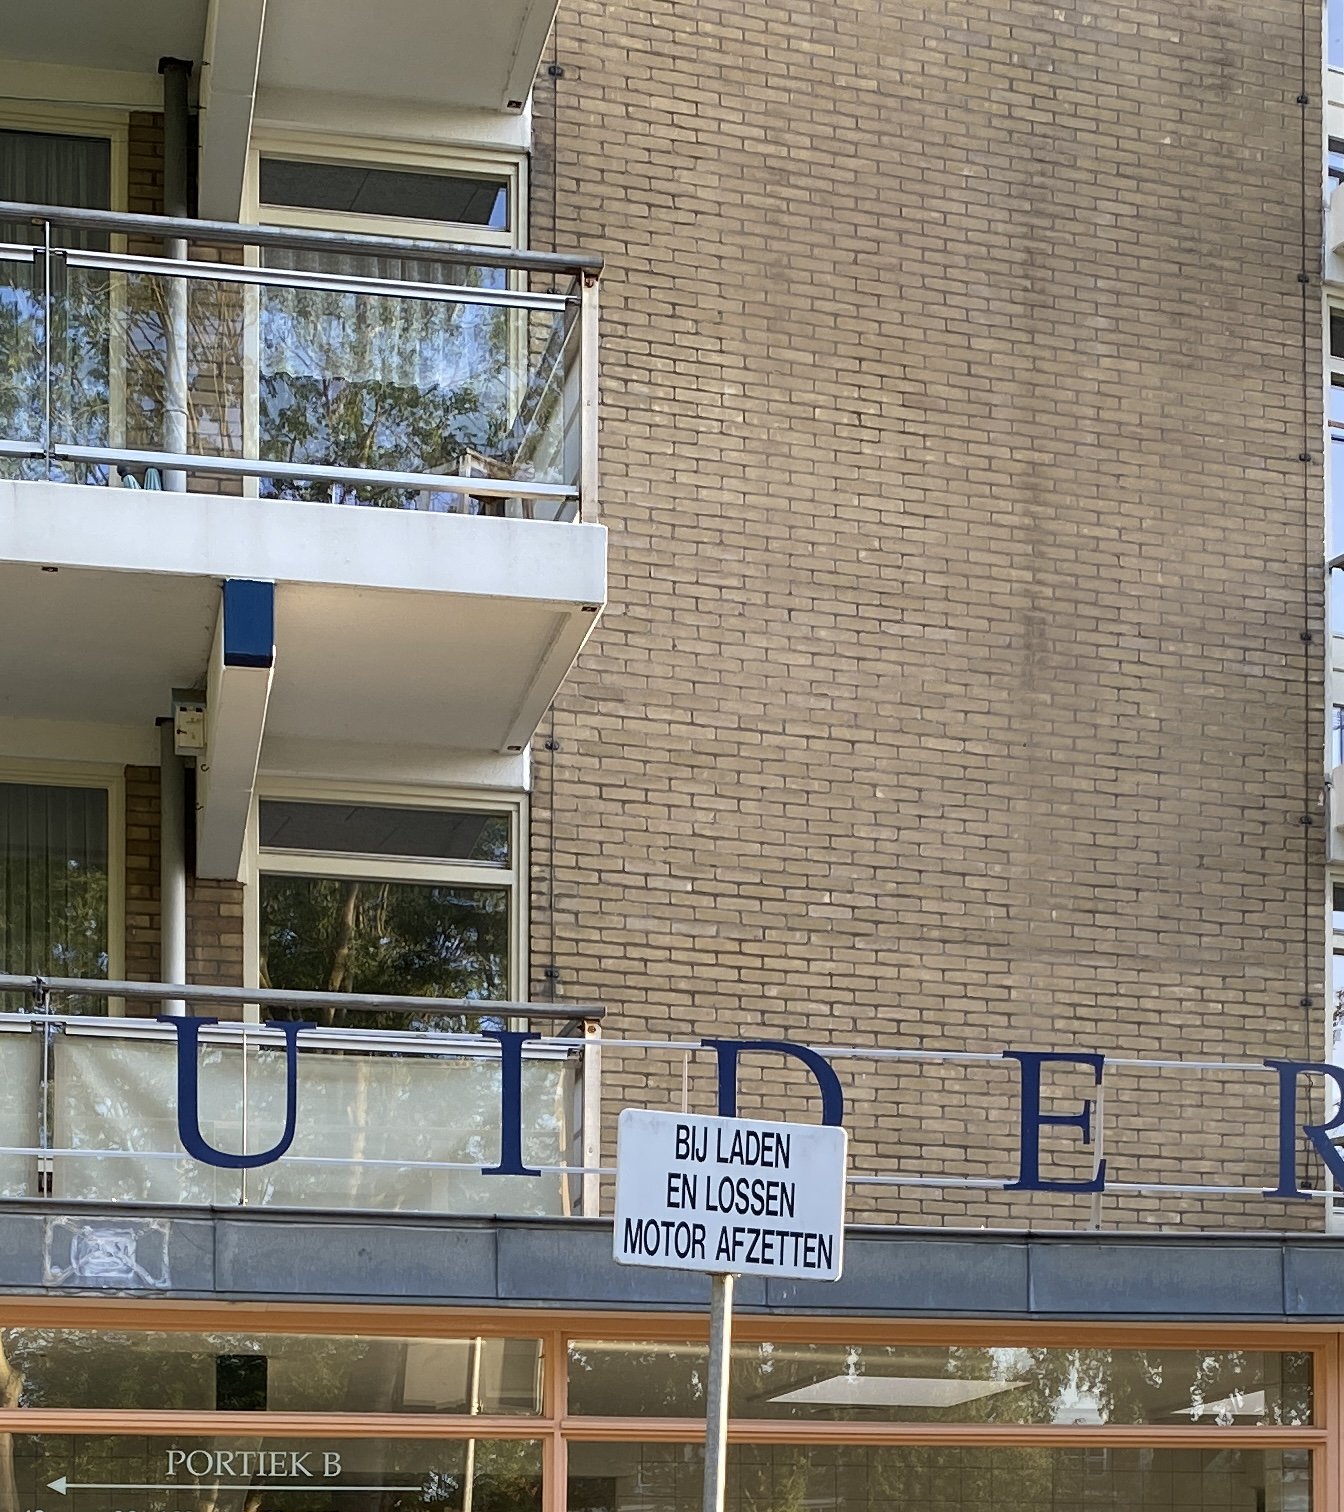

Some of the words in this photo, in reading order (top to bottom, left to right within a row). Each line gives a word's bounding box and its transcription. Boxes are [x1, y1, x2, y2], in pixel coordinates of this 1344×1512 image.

[675, 1124, 707, 1162] BIJ
[716, 1127, 791, 1169] LADEN
[667, 1172, 697, 1210] EN
[705, 1176, 796, 1218] LOSSEN
[623, 1217, 706, 1260] MOTOR
[715, 1225, 834, 1270] AFZETTEN
[166, 1450, 313, 1476] PORTIEK
[323, 1452, 341, 1476] B
